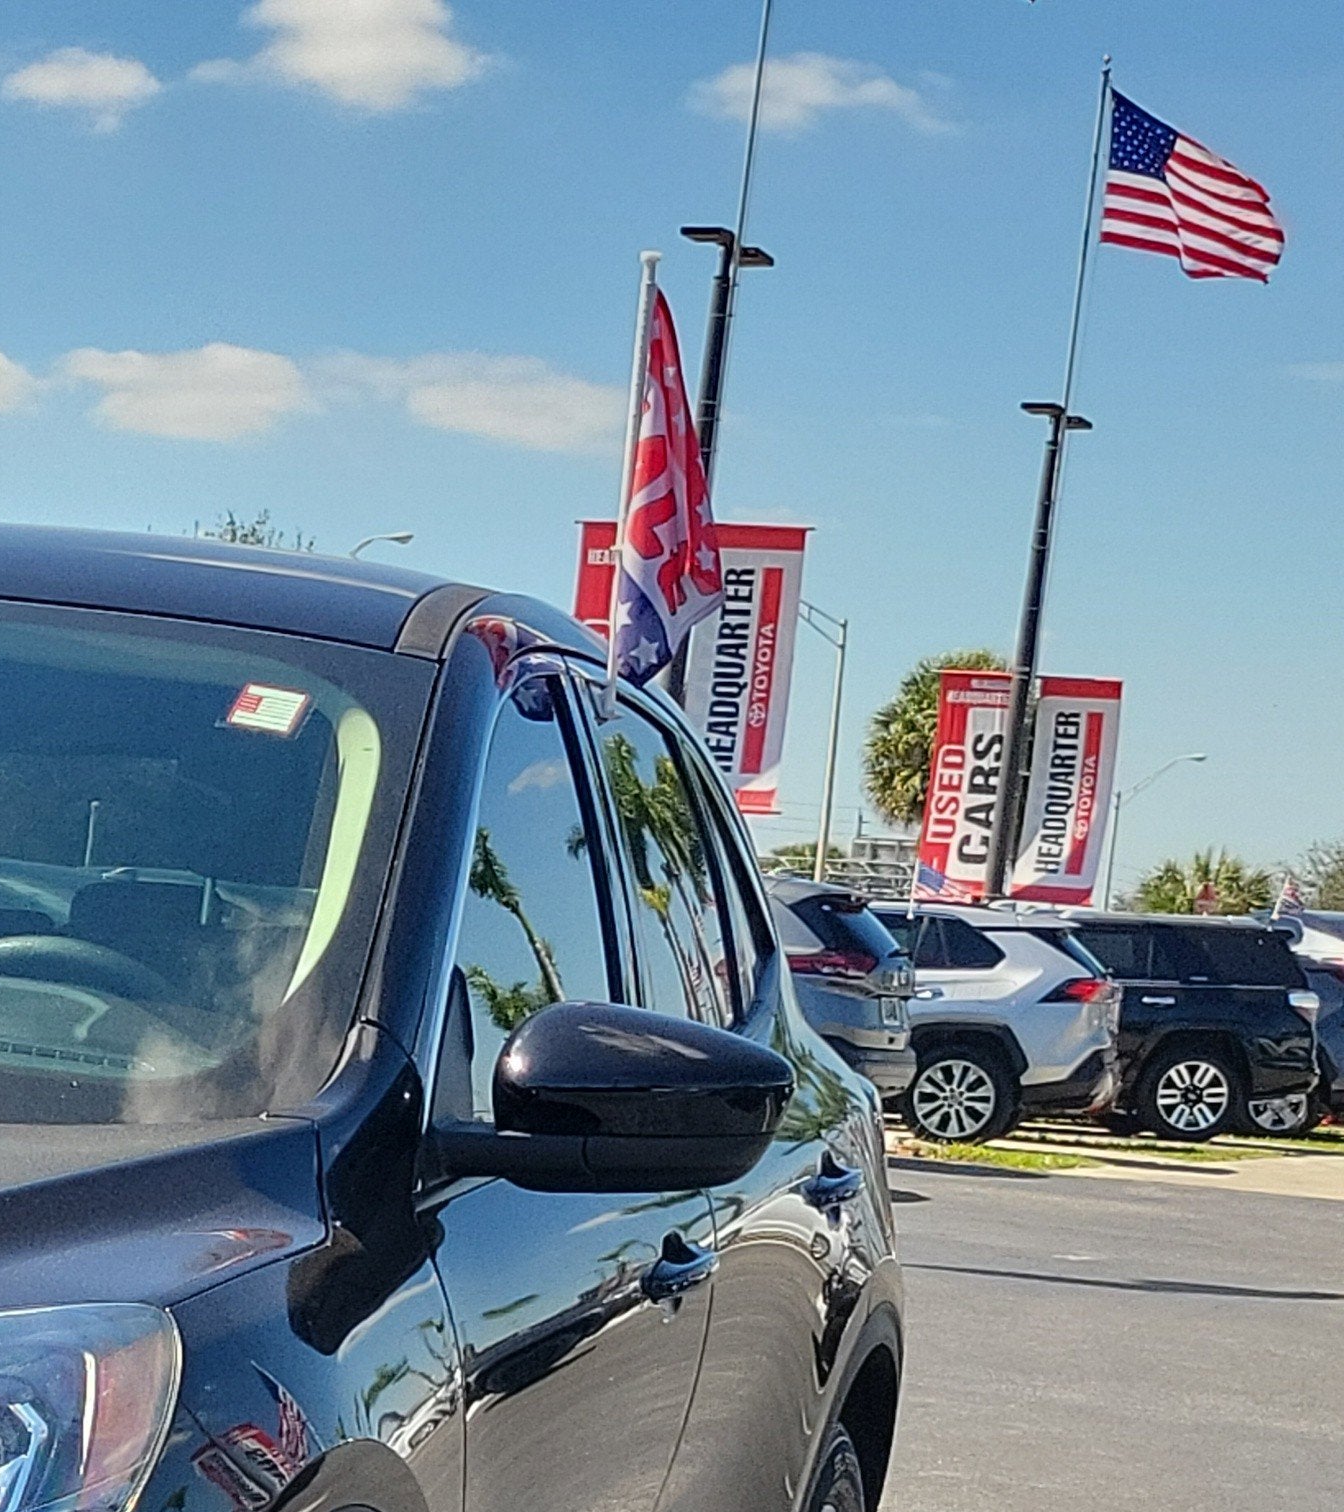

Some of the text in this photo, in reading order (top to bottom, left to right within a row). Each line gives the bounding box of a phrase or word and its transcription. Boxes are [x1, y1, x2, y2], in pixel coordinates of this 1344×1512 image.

[751, 622, 776, 708] TOYOTA
[928, 746, 966, 842] USED
[958, 732, 1005, 866] CARS
[1033, 710, 1083, 875] HEADQUARTER
[1076, 755, 1097, 823] TOYOTA
